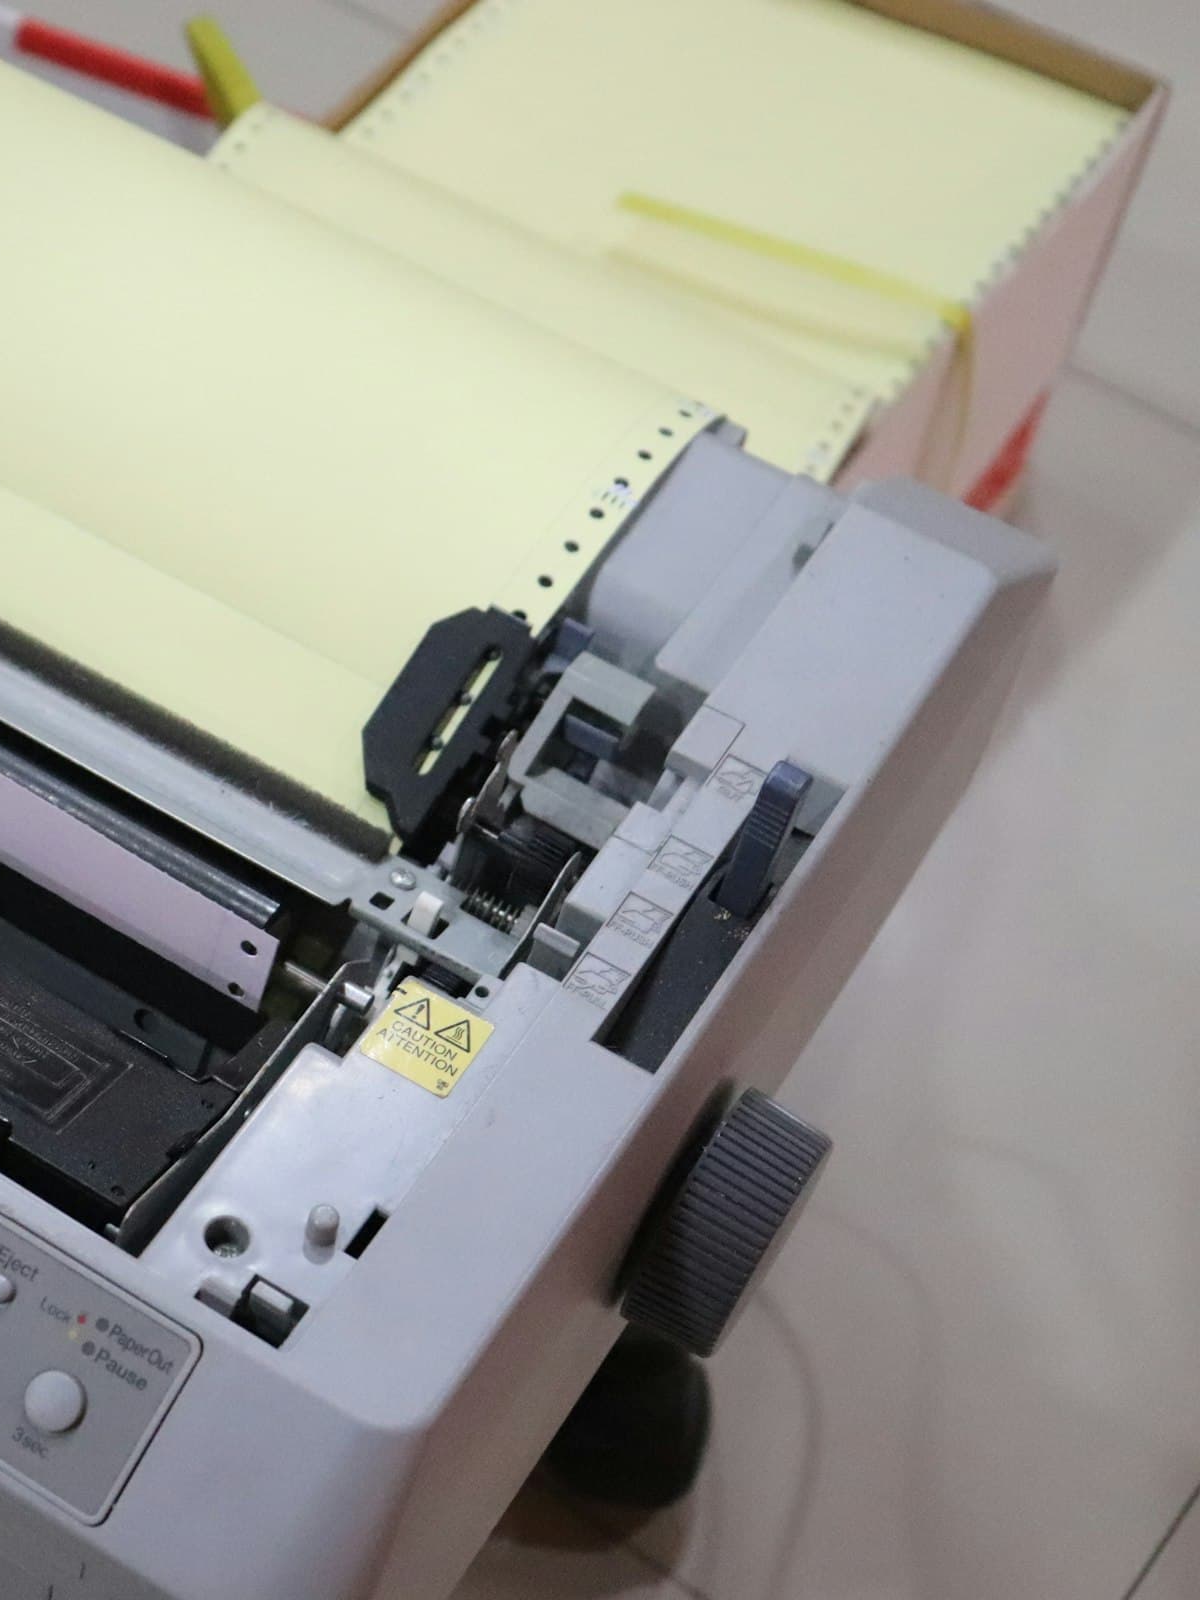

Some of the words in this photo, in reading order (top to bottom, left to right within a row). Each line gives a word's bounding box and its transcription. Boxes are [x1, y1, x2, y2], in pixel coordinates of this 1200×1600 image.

[376, 1028, 459, 1077] ATTENTION
[391, 1020, 459, 1062] CAUTION
[39, 1295, 72, 1324] Lock
[93, 1349, 149, 1391] Pause
